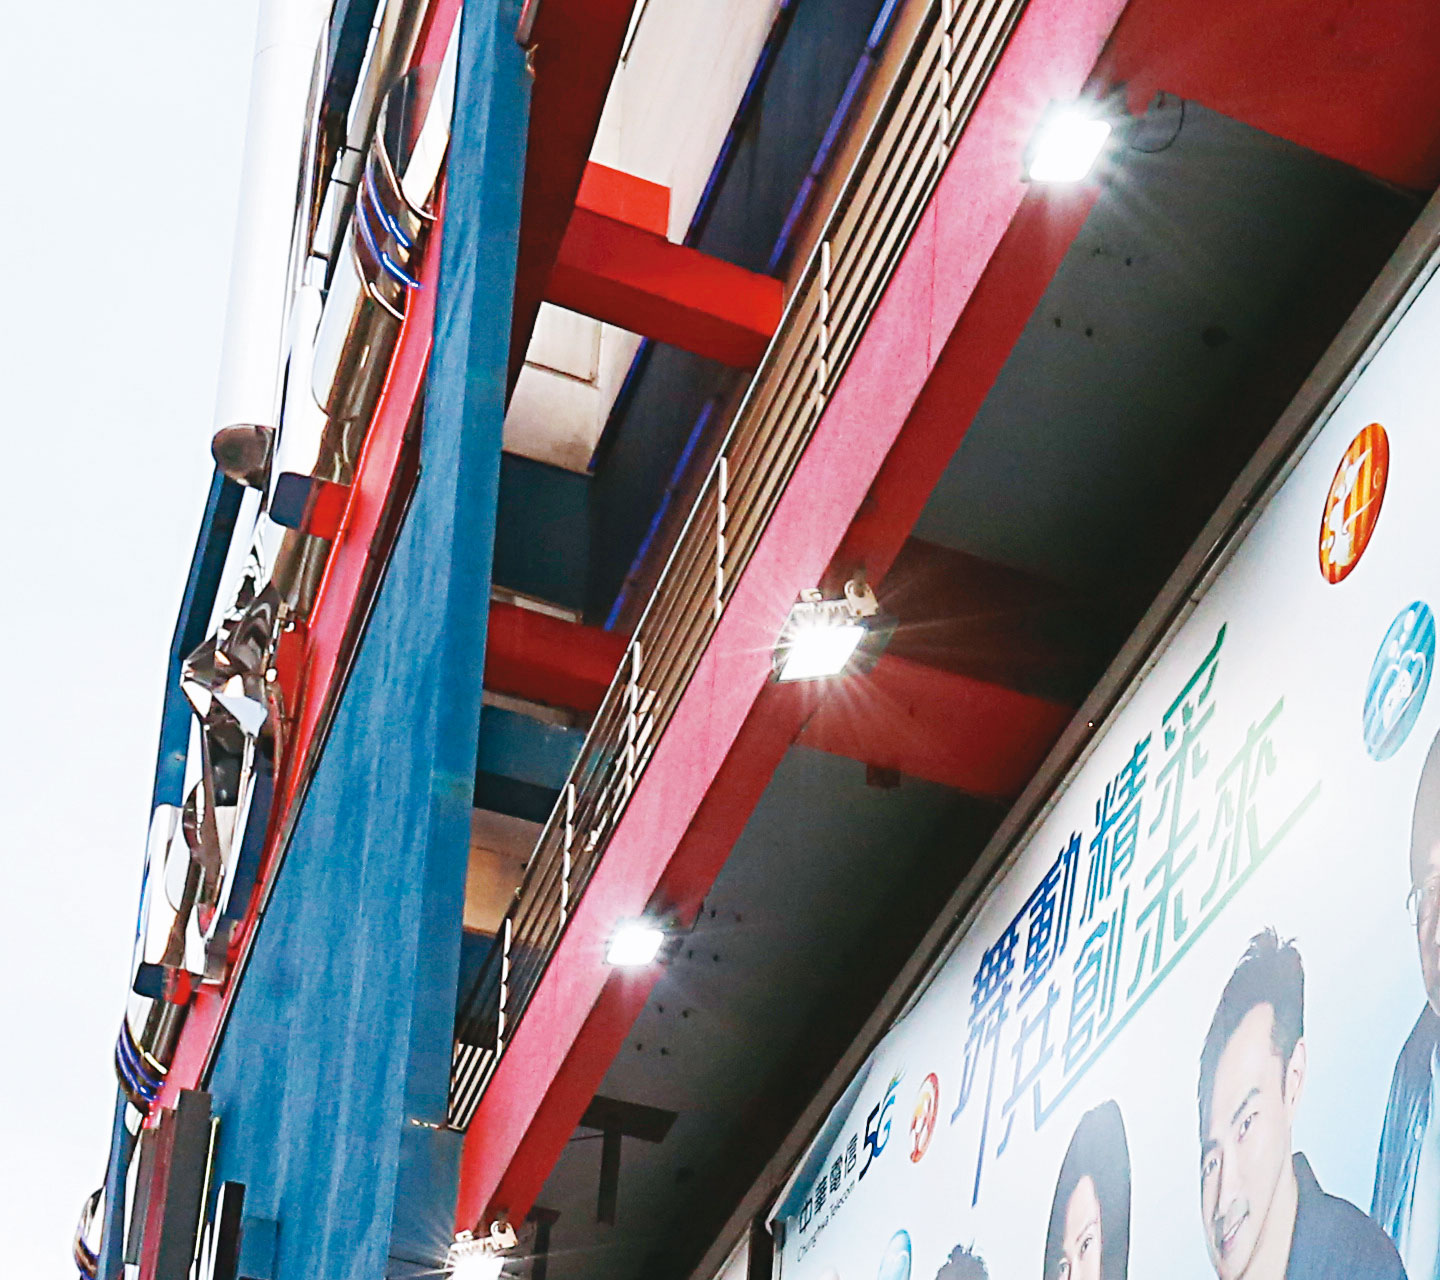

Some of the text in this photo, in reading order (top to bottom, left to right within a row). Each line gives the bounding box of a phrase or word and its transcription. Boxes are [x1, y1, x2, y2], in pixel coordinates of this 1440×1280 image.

[798, 1132, 858, 1234] 中華電信
[859, 1095, 896, 1182] 5G
